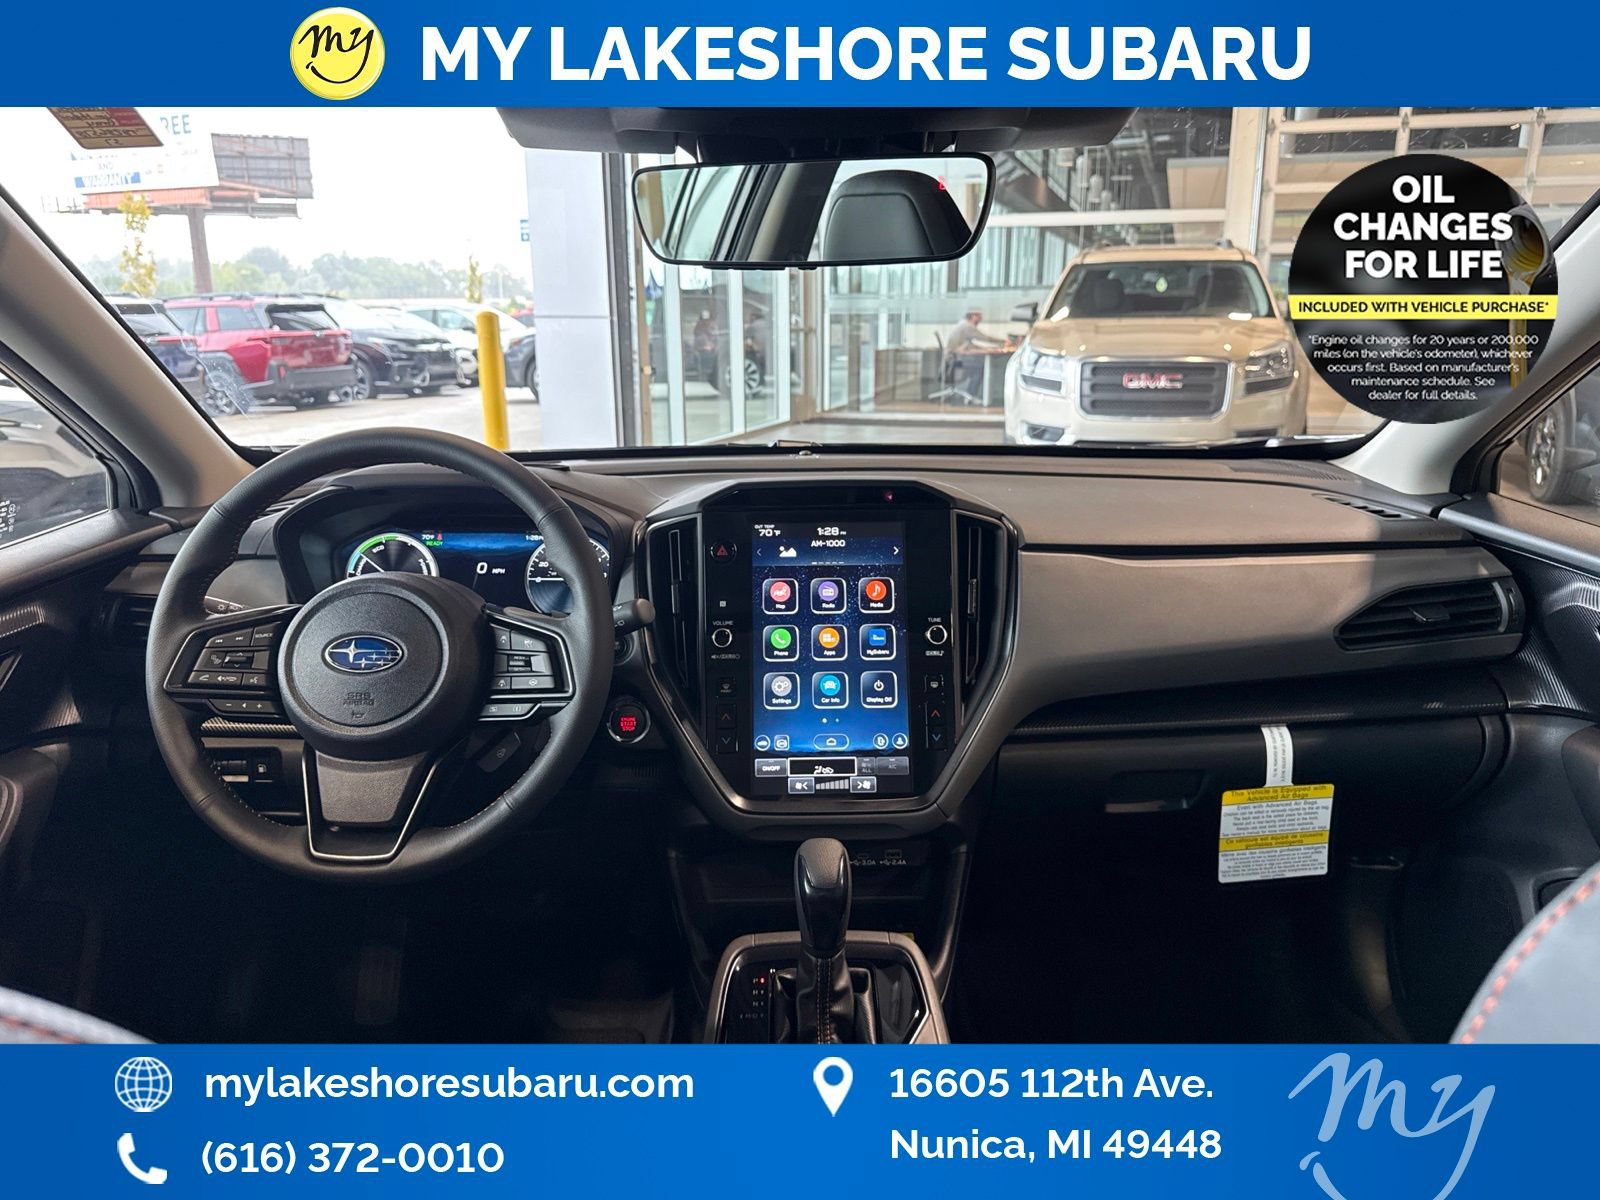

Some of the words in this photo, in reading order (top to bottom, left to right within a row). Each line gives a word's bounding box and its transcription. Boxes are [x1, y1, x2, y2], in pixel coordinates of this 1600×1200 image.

[1122, 373, 1184, 389] GMC
[817, 527, 839, 536] 1:28
[476, 561, 488, 574] 0
